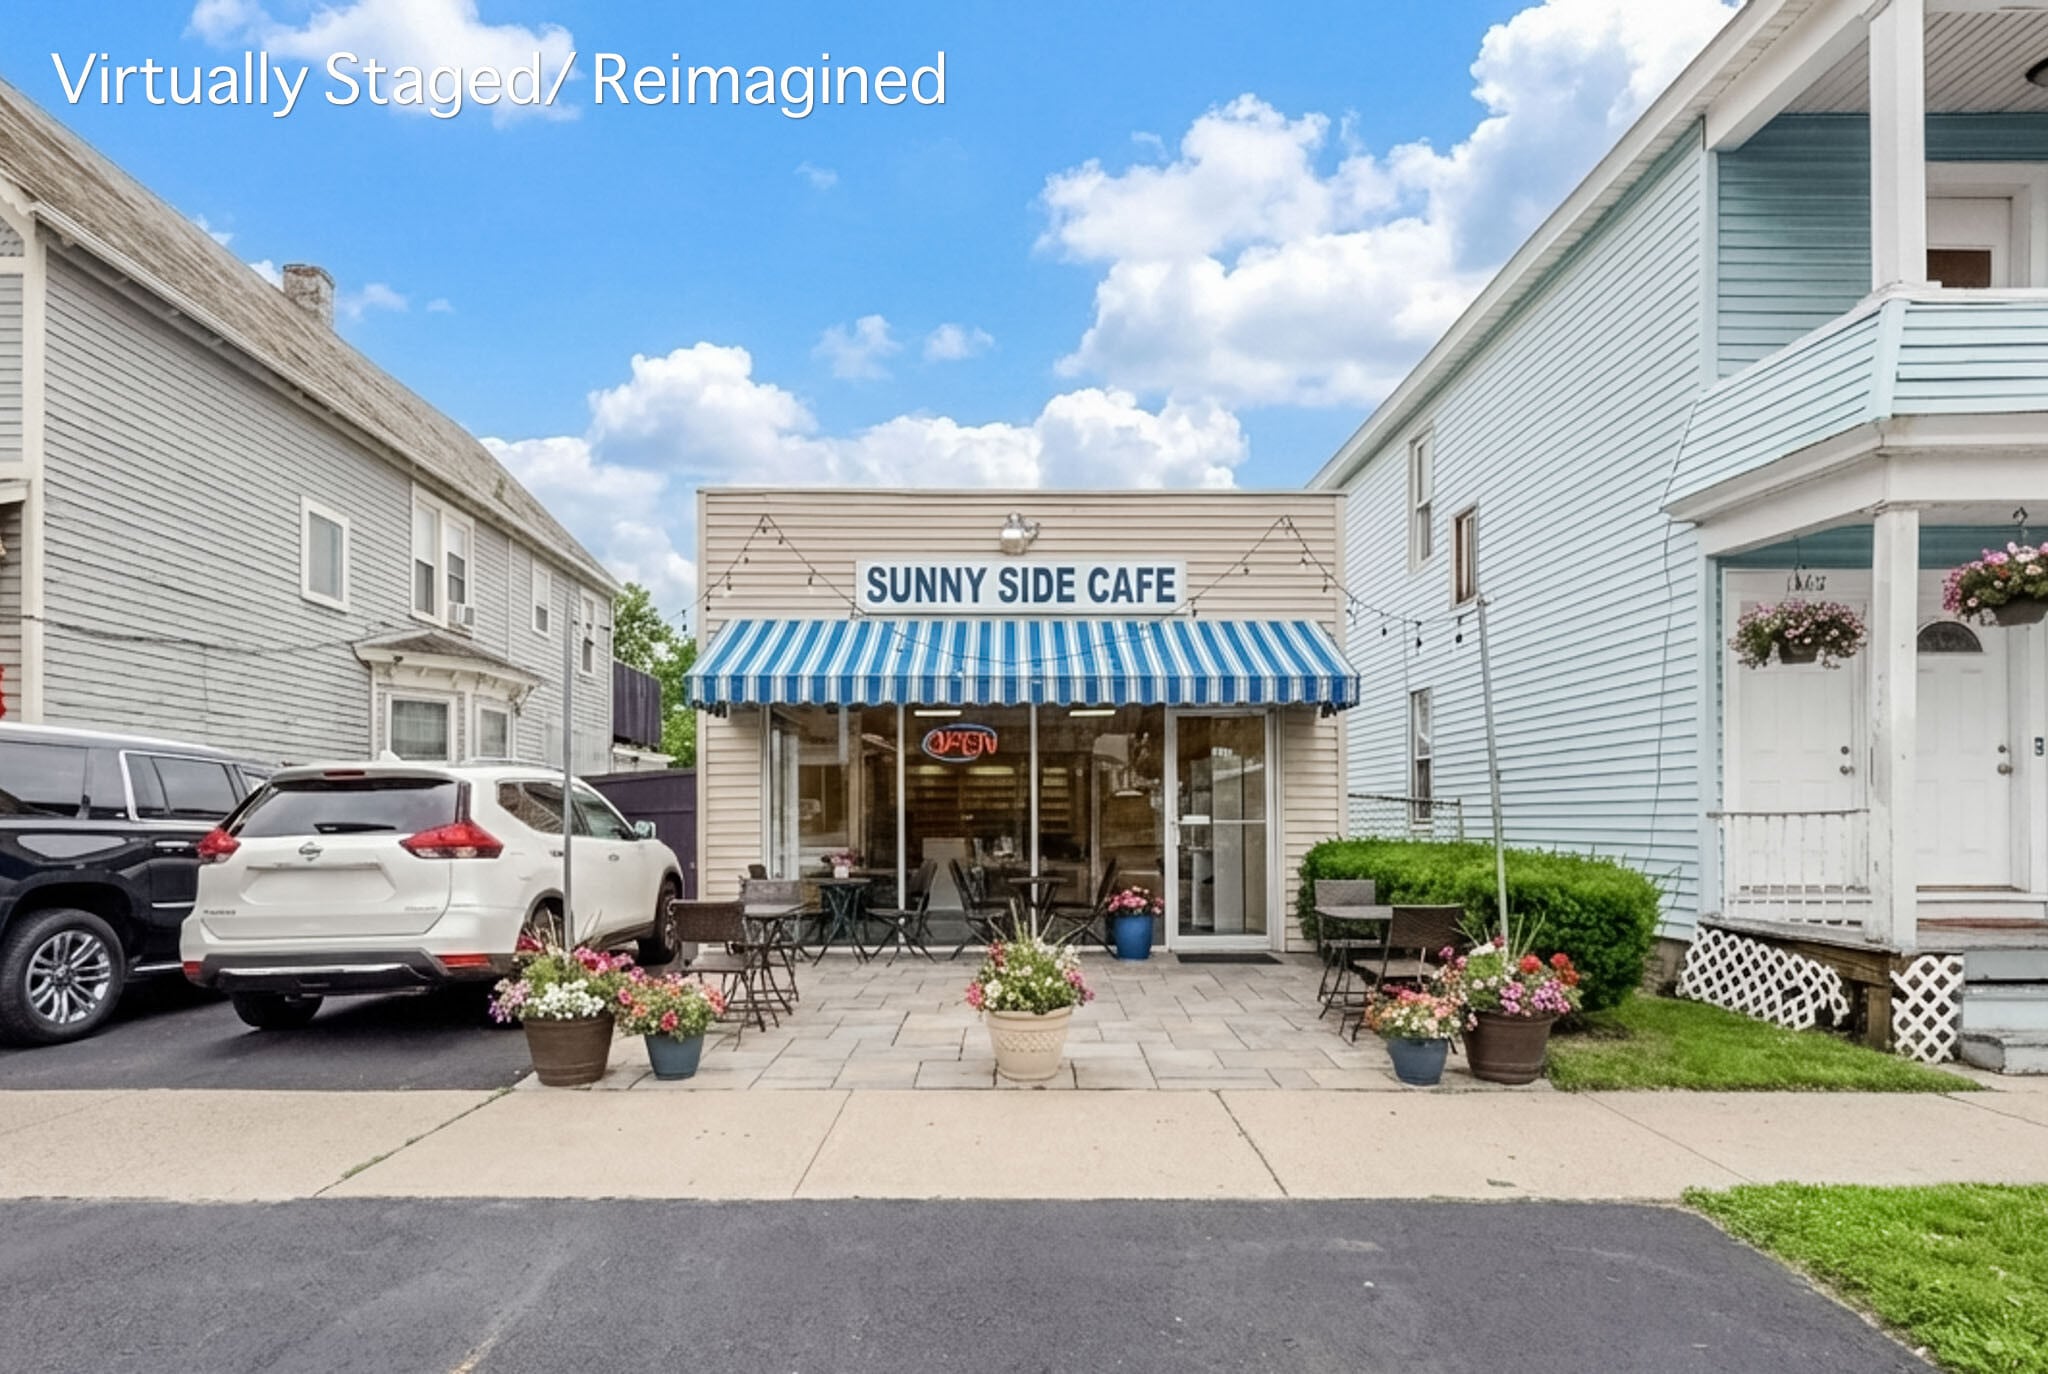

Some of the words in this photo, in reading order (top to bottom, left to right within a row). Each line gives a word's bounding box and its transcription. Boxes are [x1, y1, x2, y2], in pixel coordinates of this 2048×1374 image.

[866, 566, 988, 604] SUNNY
[998, 566, 1076, 604] SIDE
[1087, 566, 1177, 604] CAFE
